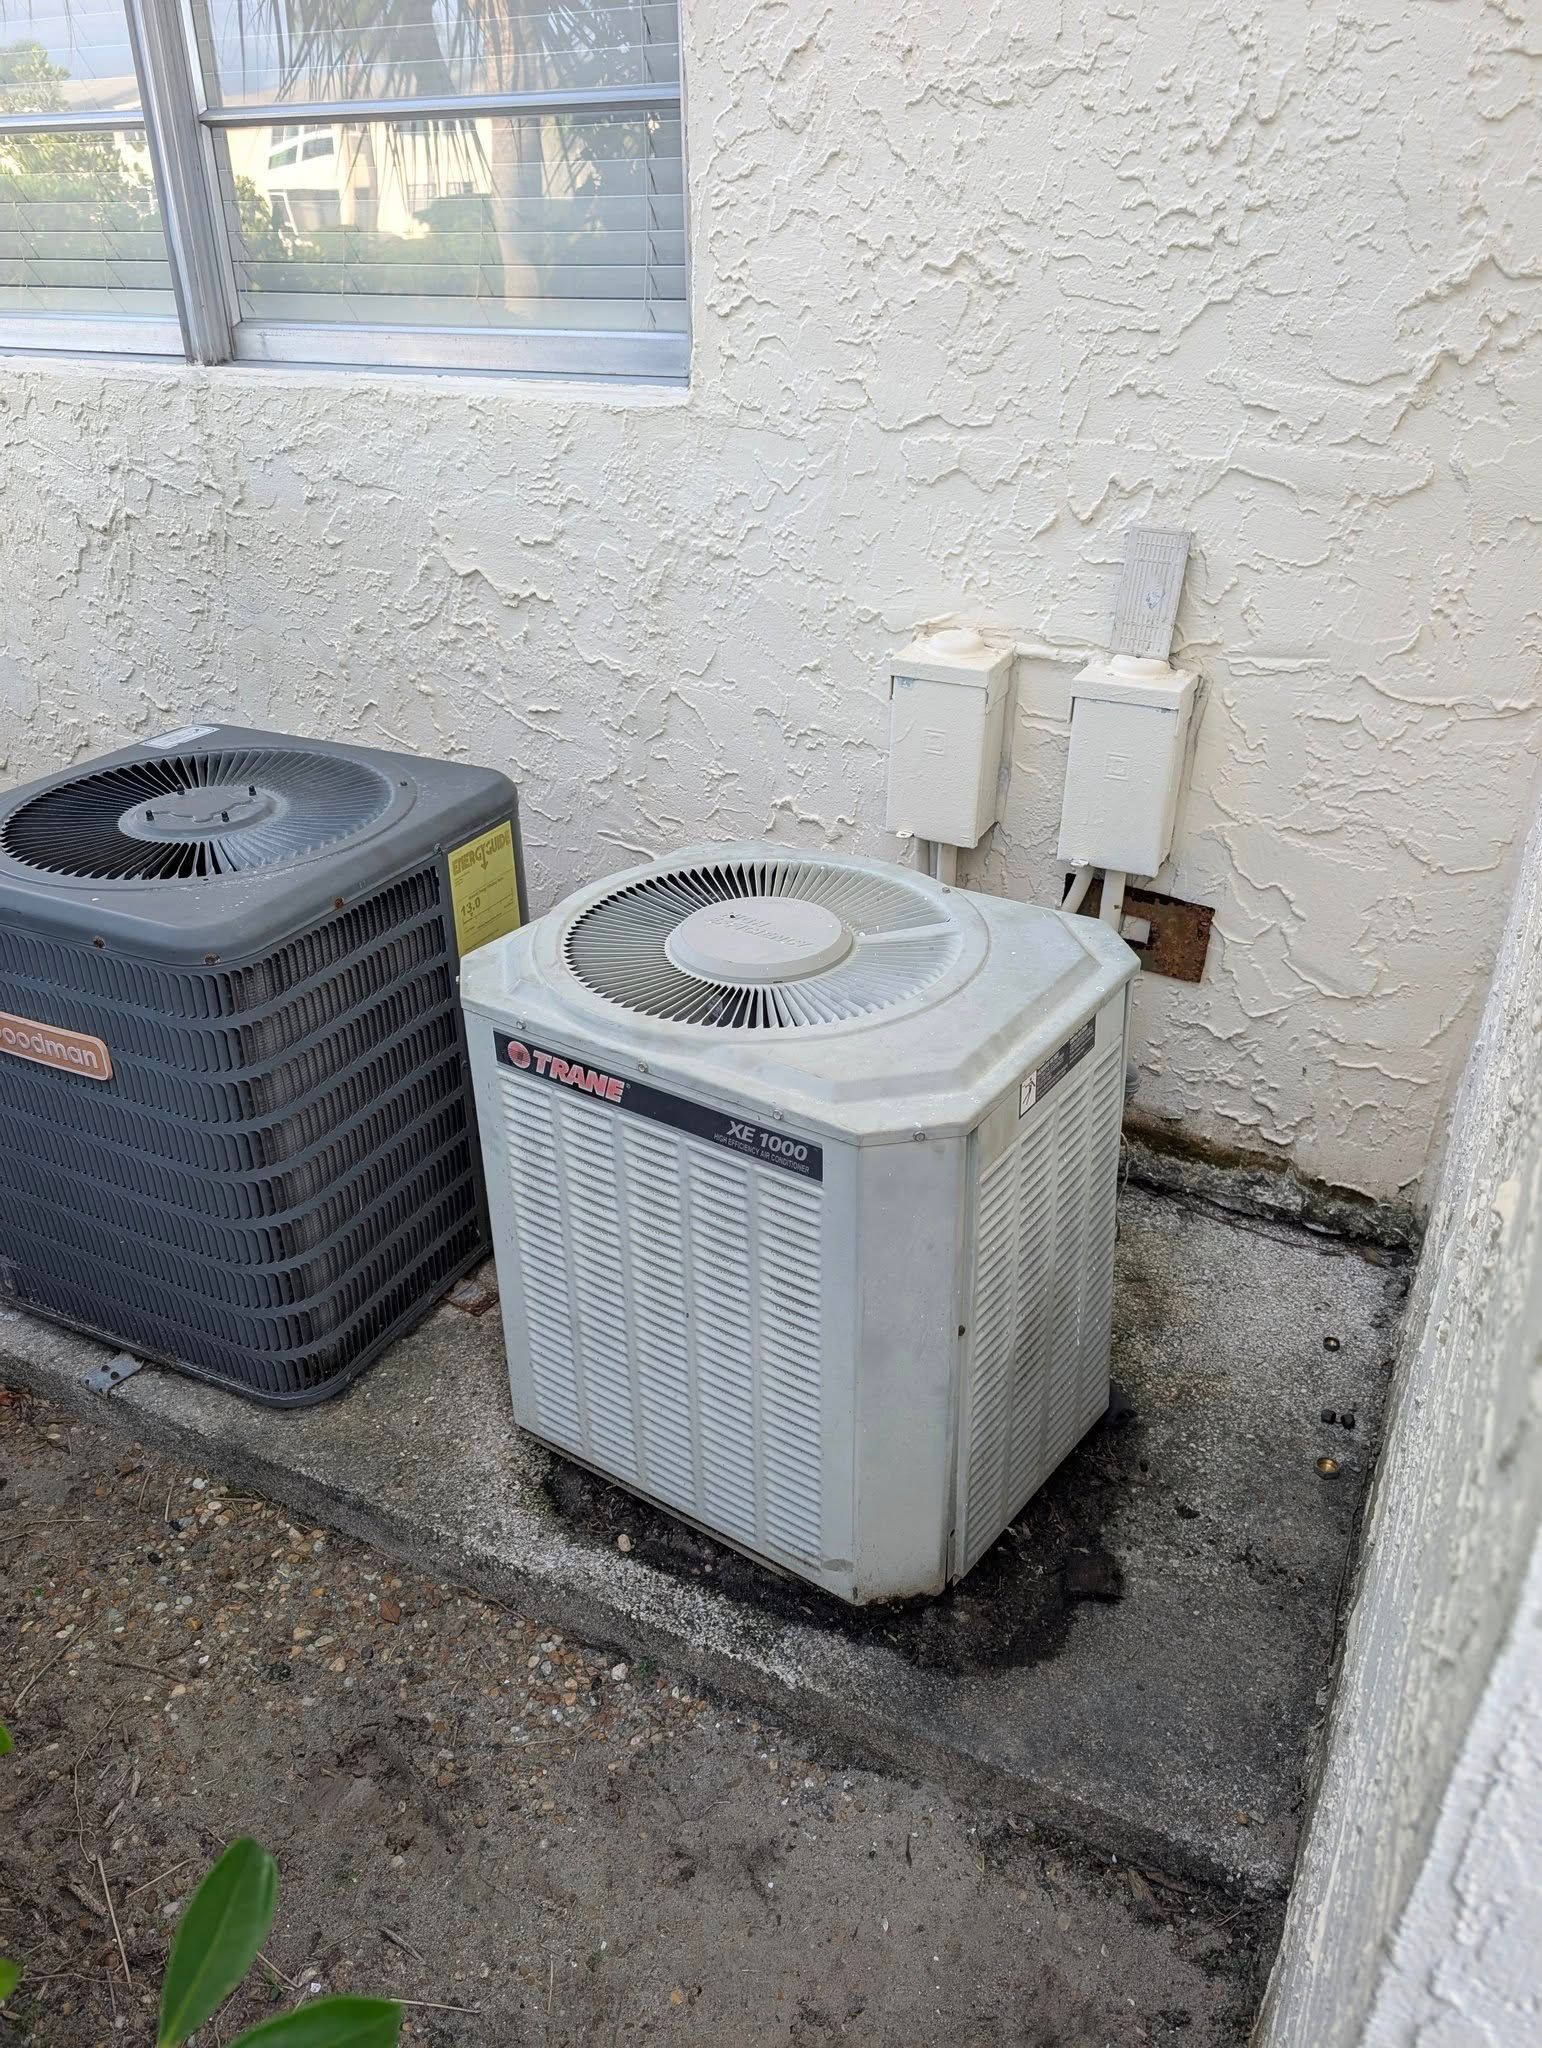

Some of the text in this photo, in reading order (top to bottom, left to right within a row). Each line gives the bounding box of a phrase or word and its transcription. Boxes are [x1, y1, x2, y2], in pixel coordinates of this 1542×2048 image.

[460, 896, 481, 917] 13.0
[0, 1026, 99, 1069] oodman
[532, 1049, 626, 1104] TRANE
[714, 1133, 810, 1174] HIGH EFFICIENCY AIR CONDITIONER
[726, 1120, 808, 1161] XE 1000
